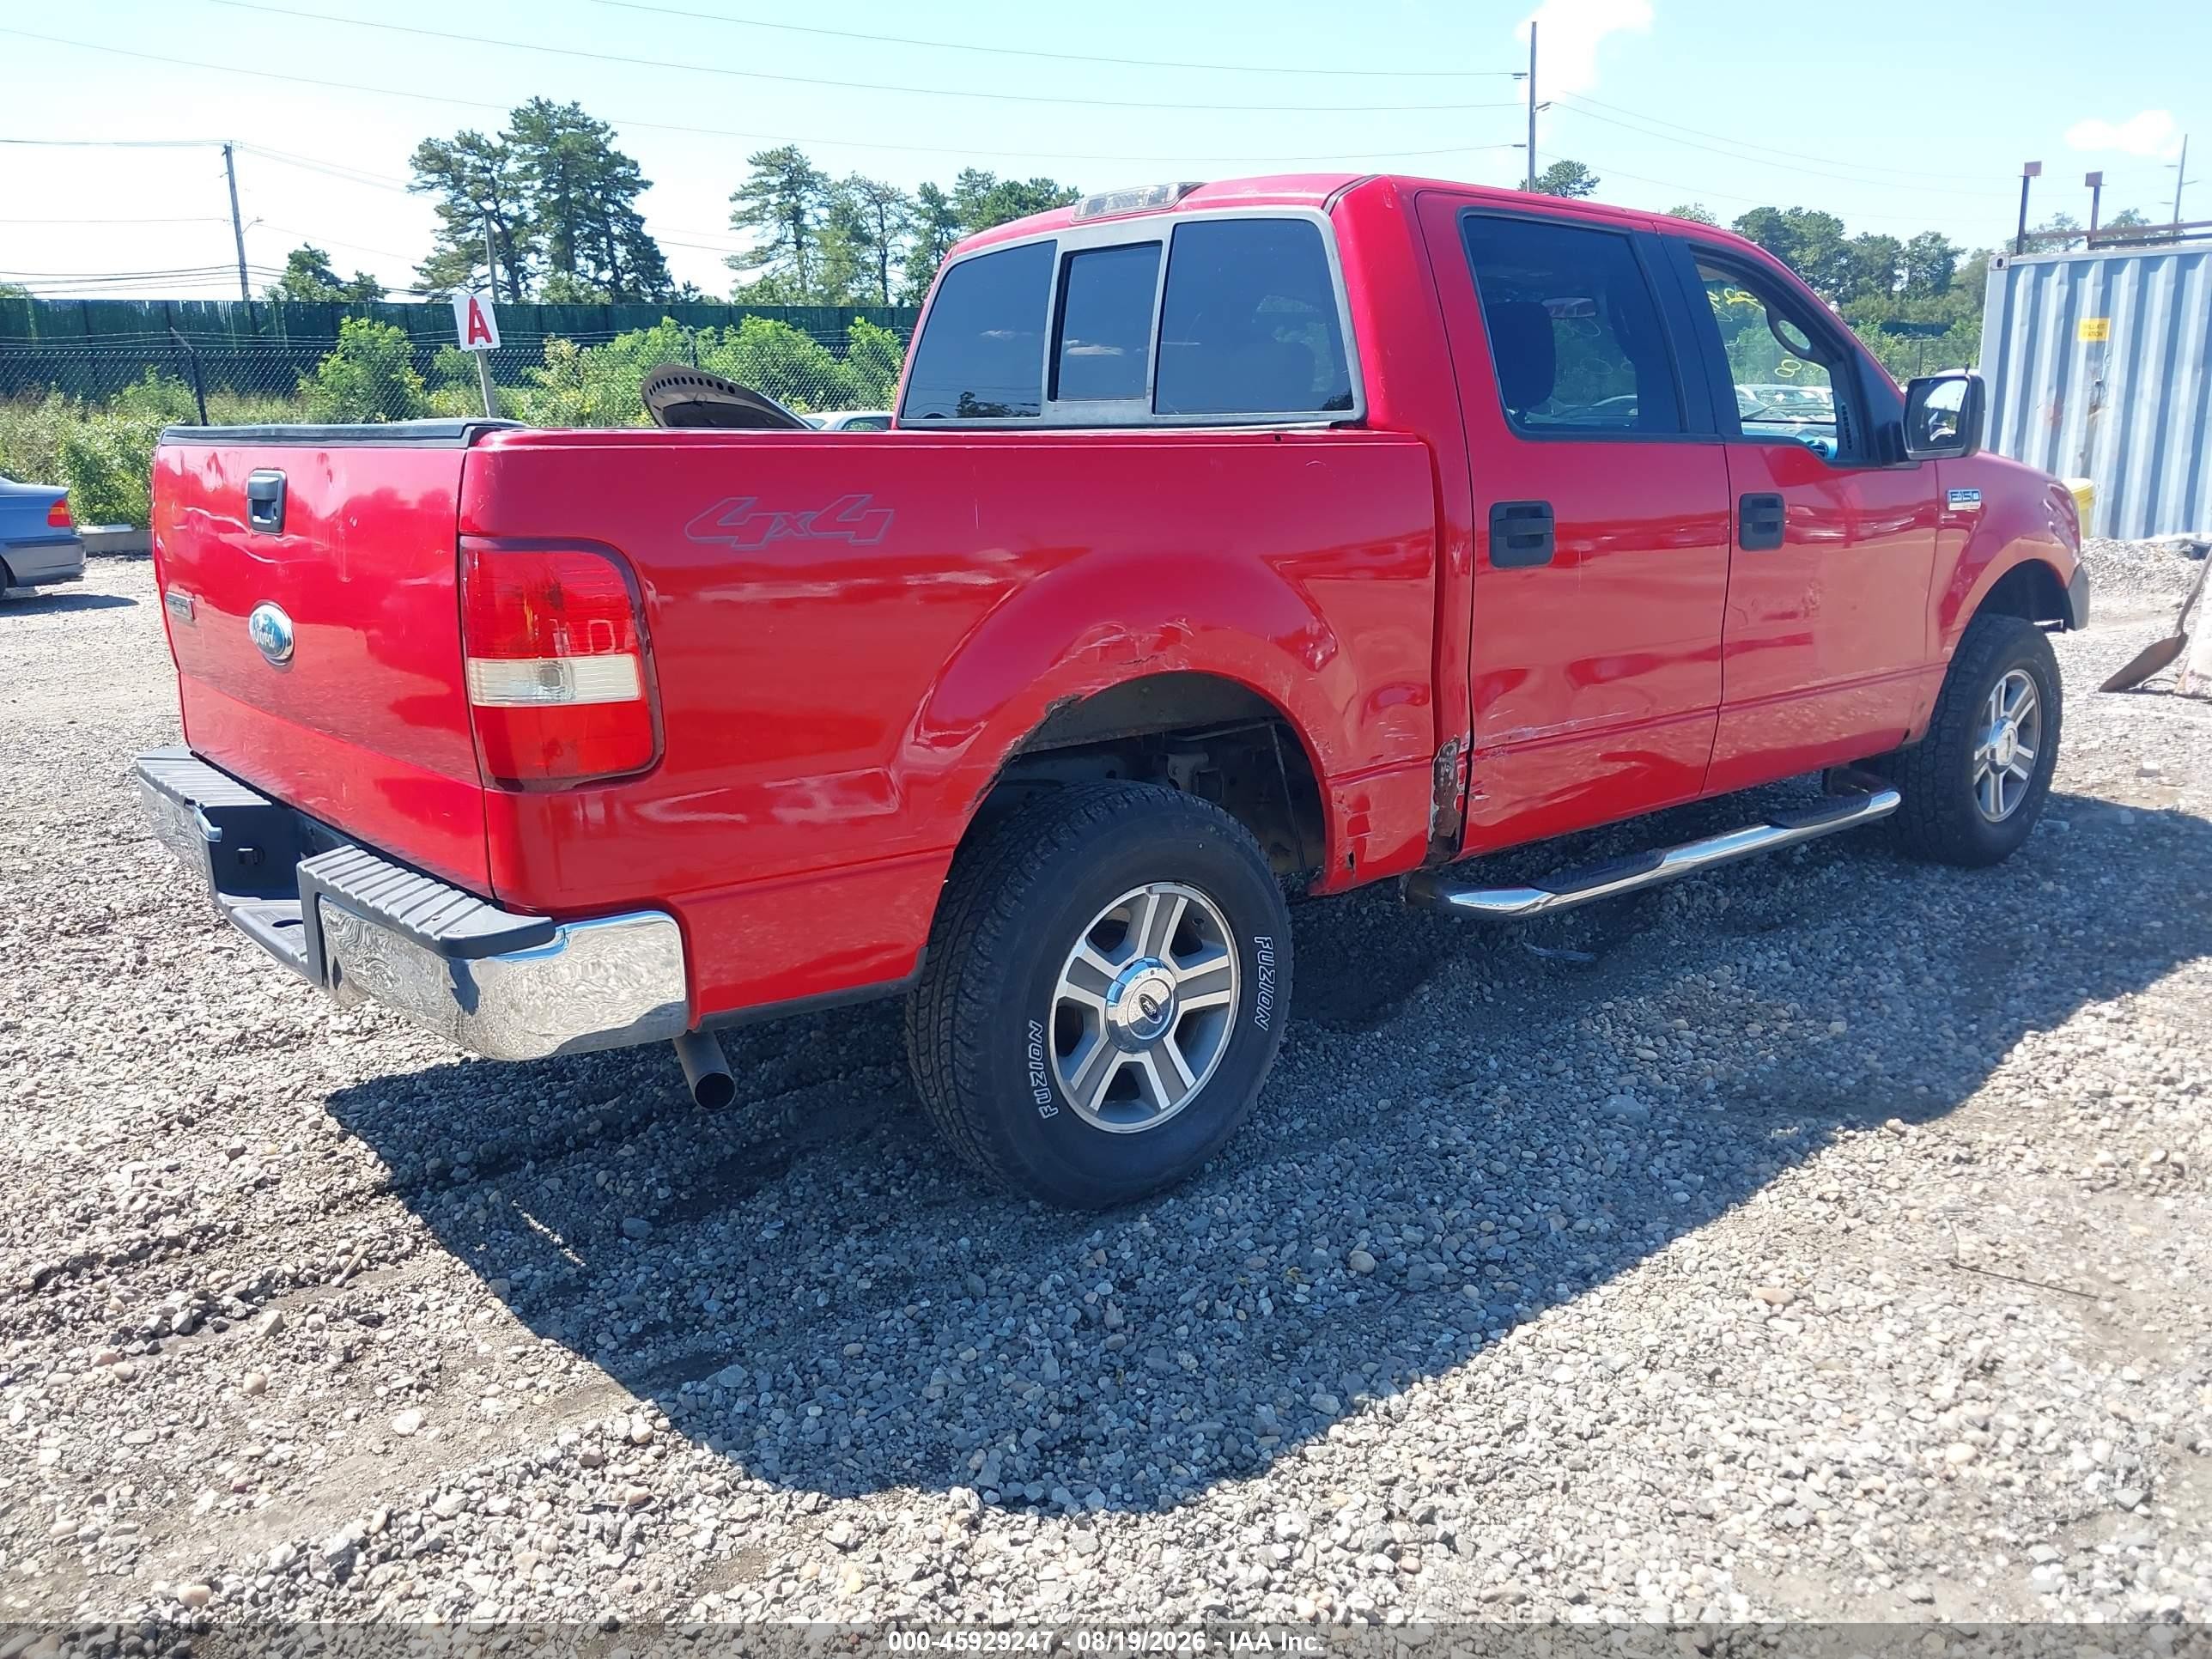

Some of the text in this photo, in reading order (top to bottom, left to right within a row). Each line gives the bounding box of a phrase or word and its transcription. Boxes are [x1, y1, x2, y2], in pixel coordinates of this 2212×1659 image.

[468, 297, 493, 344] A
[1254, 936, 1275, 1031] FUZION
[1029, 1019, 1059, 1120] FUZION
